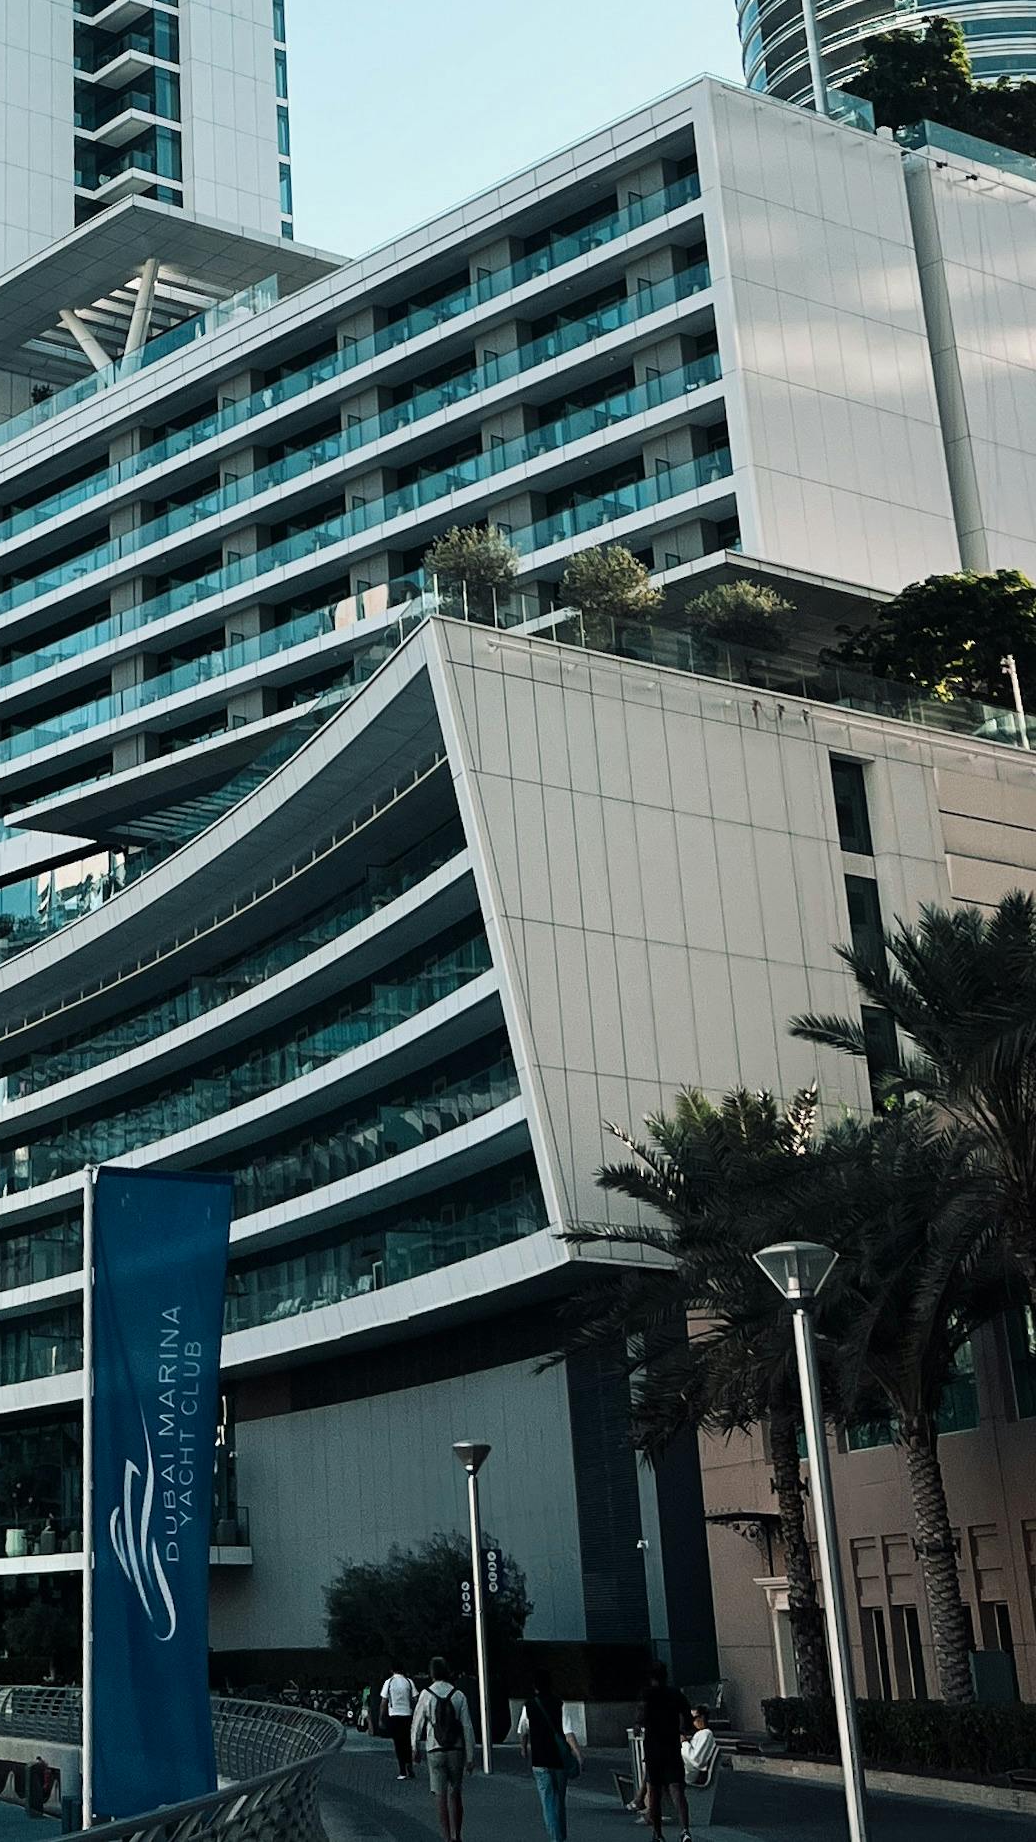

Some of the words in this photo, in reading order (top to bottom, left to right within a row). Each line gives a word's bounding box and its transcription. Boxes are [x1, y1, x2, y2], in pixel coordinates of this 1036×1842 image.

[157, 1305, 182, 1437] MARINA
[180, 1340, 202, 1416] CLUB
[159, 1453, 180, 1563] DUBAI
[179, 1428, 196, 1528] YACHT
